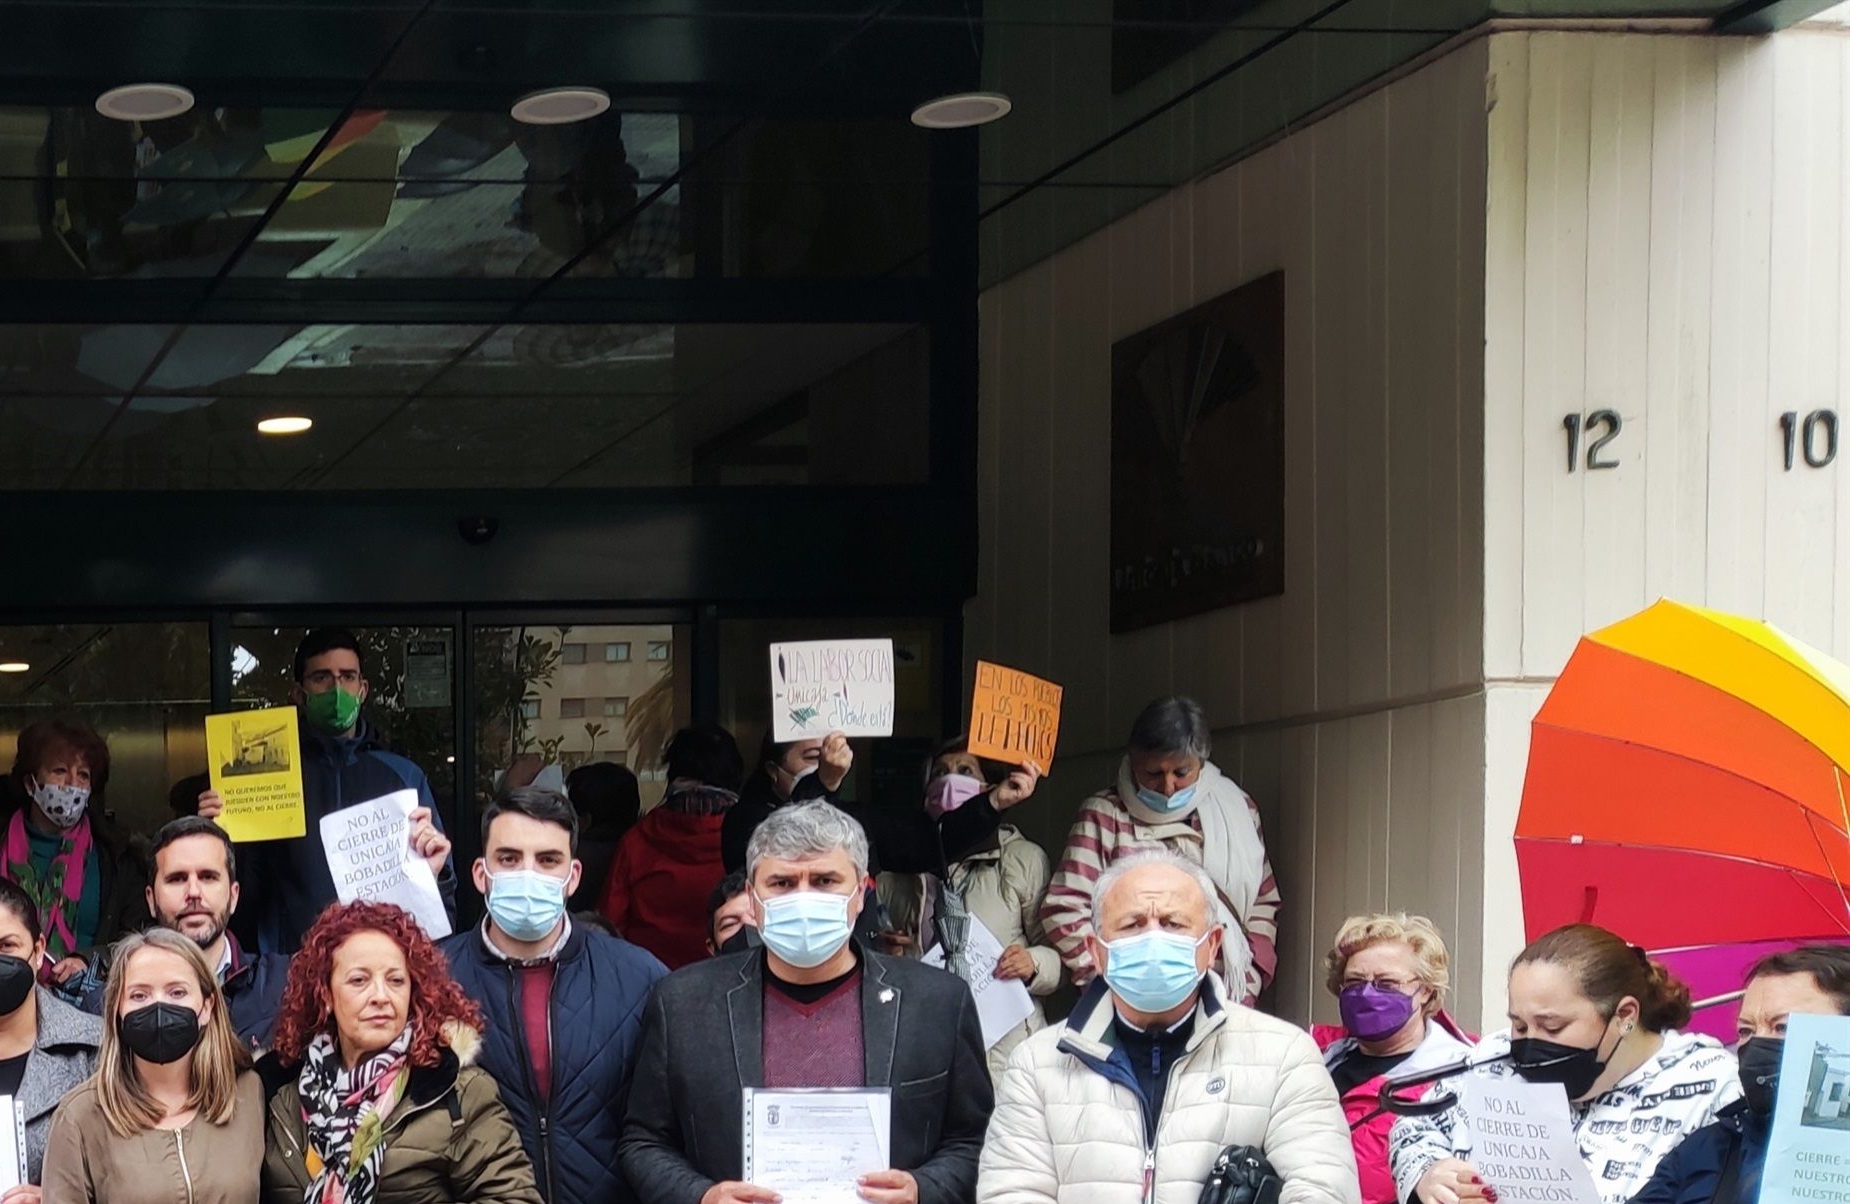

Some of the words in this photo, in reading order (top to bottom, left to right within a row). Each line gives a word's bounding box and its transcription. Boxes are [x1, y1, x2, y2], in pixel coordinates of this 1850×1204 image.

[1563, 409, 1622, 473] 12
[1780, 409, 1839, 472] 10
[347, 814, 369, 831] NO
[372, 808, 390, 824] AL
[338, 826, 389, 852] CIERRE
[390, 819, 405, 834] DE
[1484, 1096, 1503, 1113] NO
[1506, 1100, 1525, 1115] AL
[1476, 1117, 1524, 1137] CIERRE
[1526, 1124, 1550, 1139] DE
[1484, 1141, 1551, 1160] UNICAJA
[1796, 1151, 1841, 1165] CIERRE
[1478, 1161, 1572, 1181] BOBADILLA
